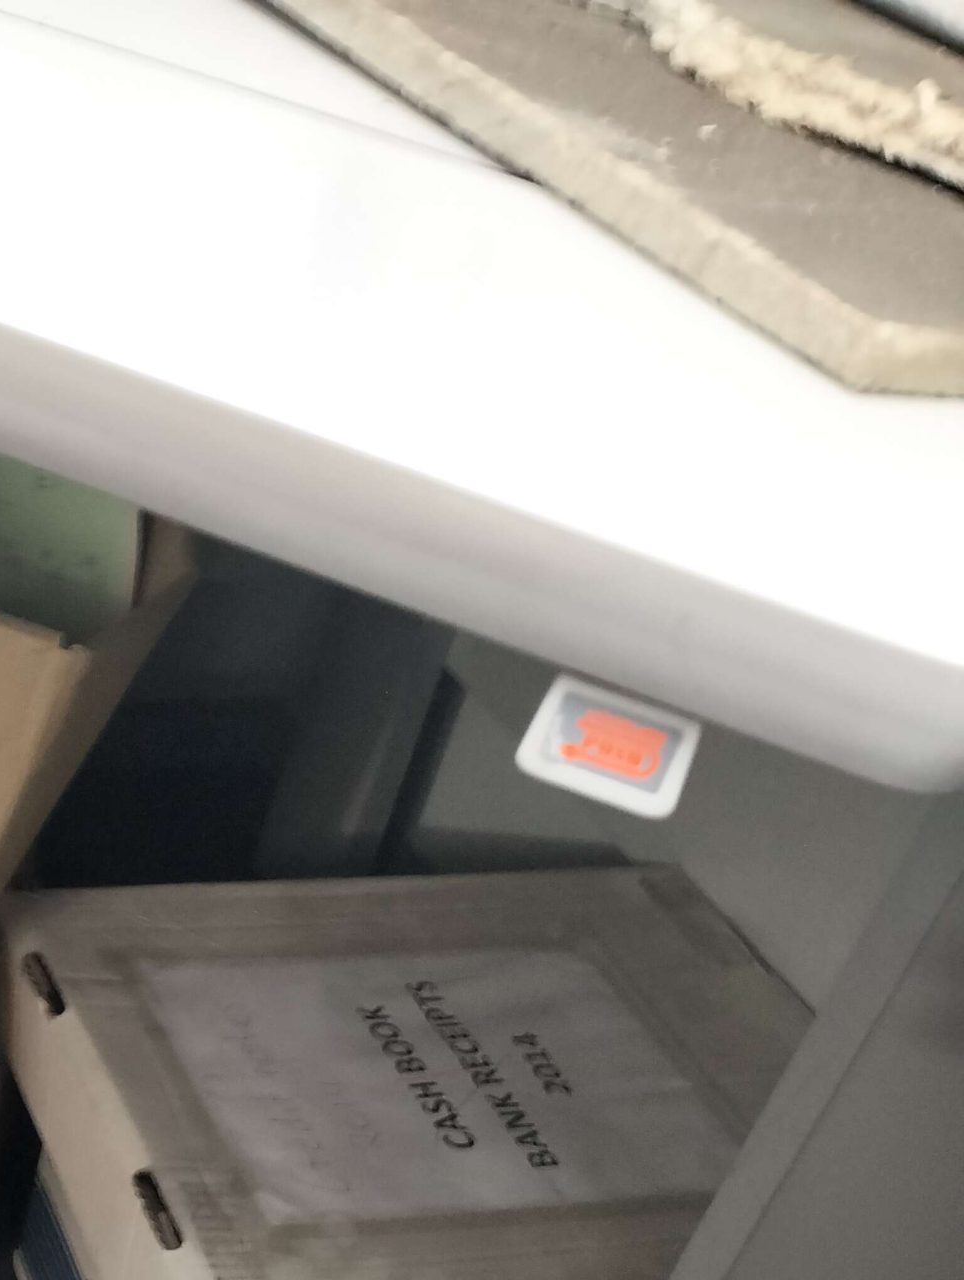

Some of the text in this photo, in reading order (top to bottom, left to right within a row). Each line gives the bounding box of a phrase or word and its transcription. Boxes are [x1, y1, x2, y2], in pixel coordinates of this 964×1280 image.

[356, 1004, 477, 1150] CASH BOOK
[404, 980, 561, 1169] BANK RECEIPTS
[510, 1031, 574, 1097] 2014
